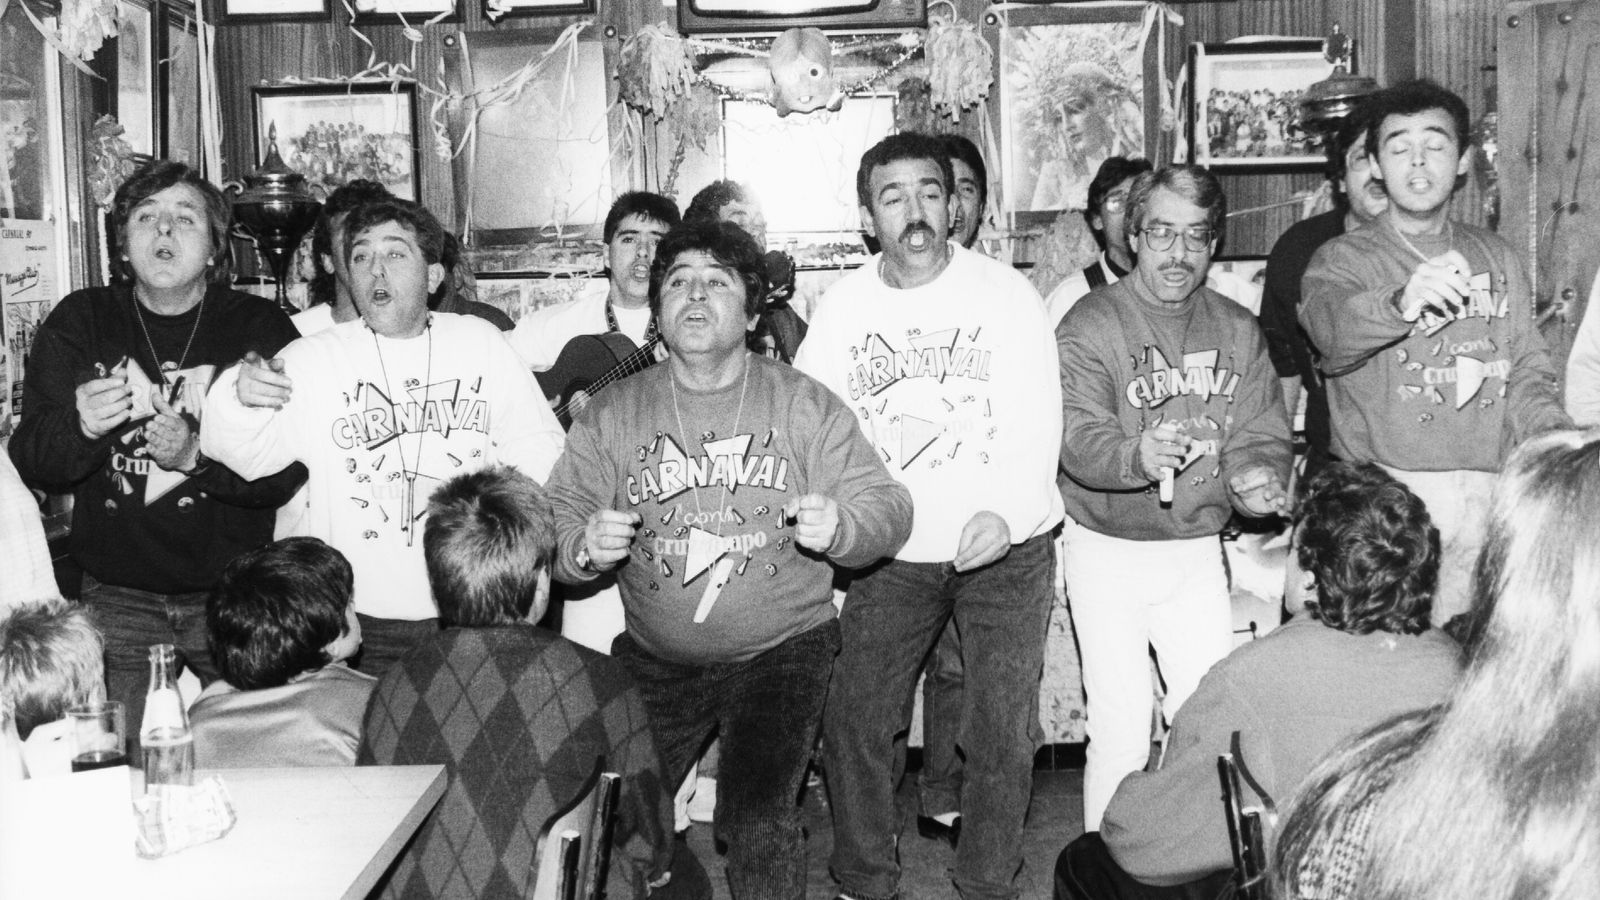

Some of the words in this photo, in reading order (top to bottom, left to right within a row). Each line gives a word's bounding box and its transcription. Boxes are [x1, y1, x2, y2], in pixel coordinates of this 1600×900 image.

[848, 346, 992, 401] CARNAVAL
[332, 399, 488, 450] CARNAVA
[627, 453, 789, 506] CARNAVAL
